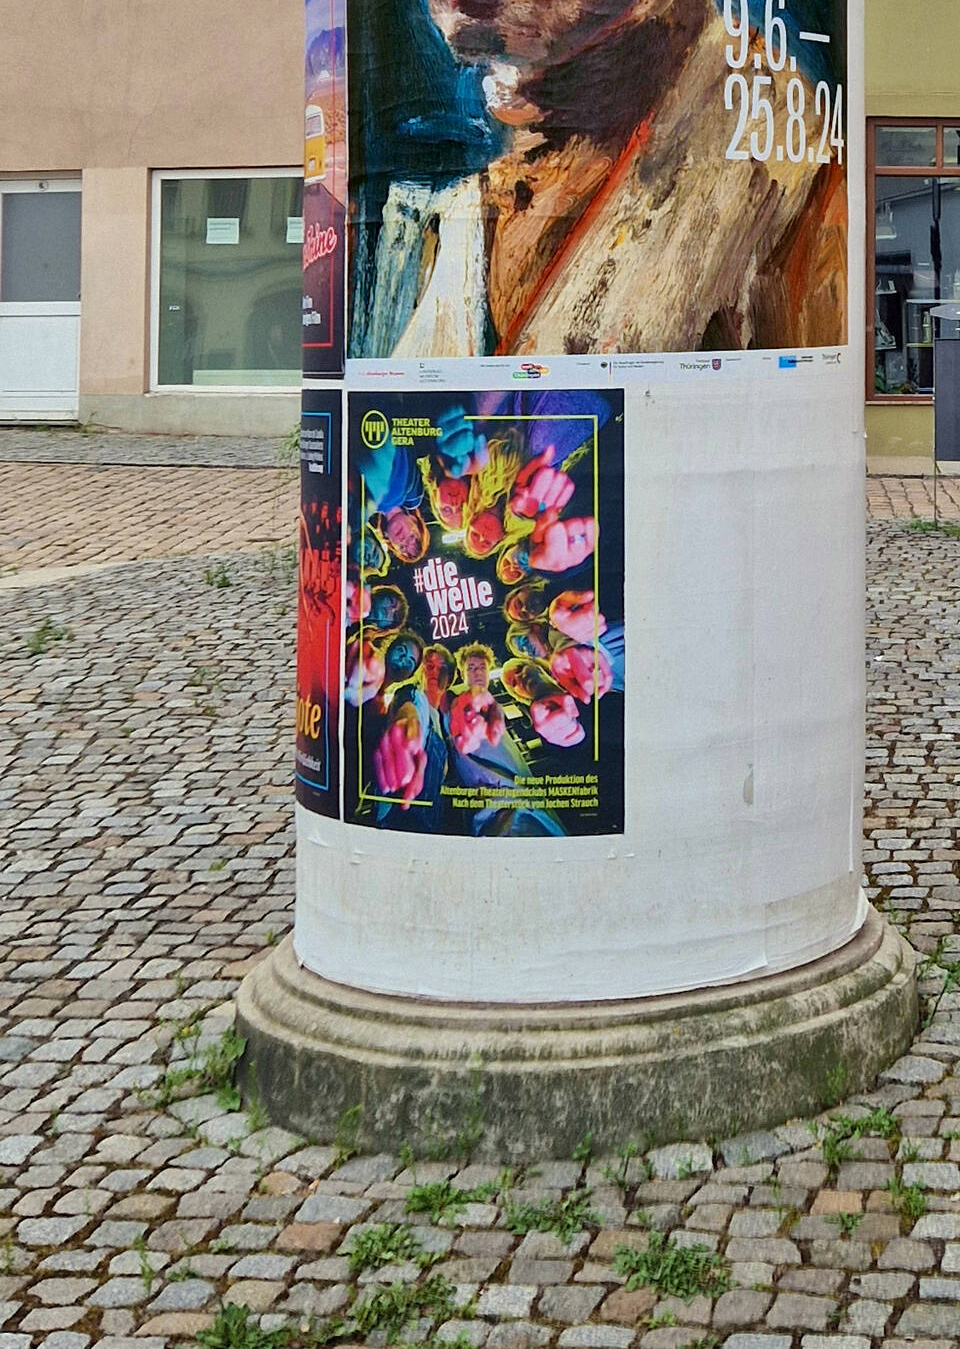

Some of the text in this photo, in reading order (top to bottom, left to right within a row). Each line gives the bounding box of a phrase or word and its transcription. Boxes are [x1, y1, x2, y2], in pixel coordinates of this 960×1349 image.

[724, 73, 844, 165] 25.8.24
[680, 363, 710, 371] Thüringen
[391, 418, 430, 427] THEATER
[391, 427, 443, 437] ALTENBURG
[391, 436, 414, 446] GERA
[413, 557, 459, 593] #die
[426, 577, 494, 616] welle
[430, 612, 469, 640] 2024
[515, 774, 598, 785] Die neue Produktion des
[441, 785, 478, 797] Altenburger
[548, 786, 598, 796] MASKENfabrik
[452, 798, 469, 808] Nach
[469, 798, 484, 808] dem
[531, 800, 545, 809] von
[546, 798, 569, 808] Jochen
[570, 797, 598, 808] Strauch
